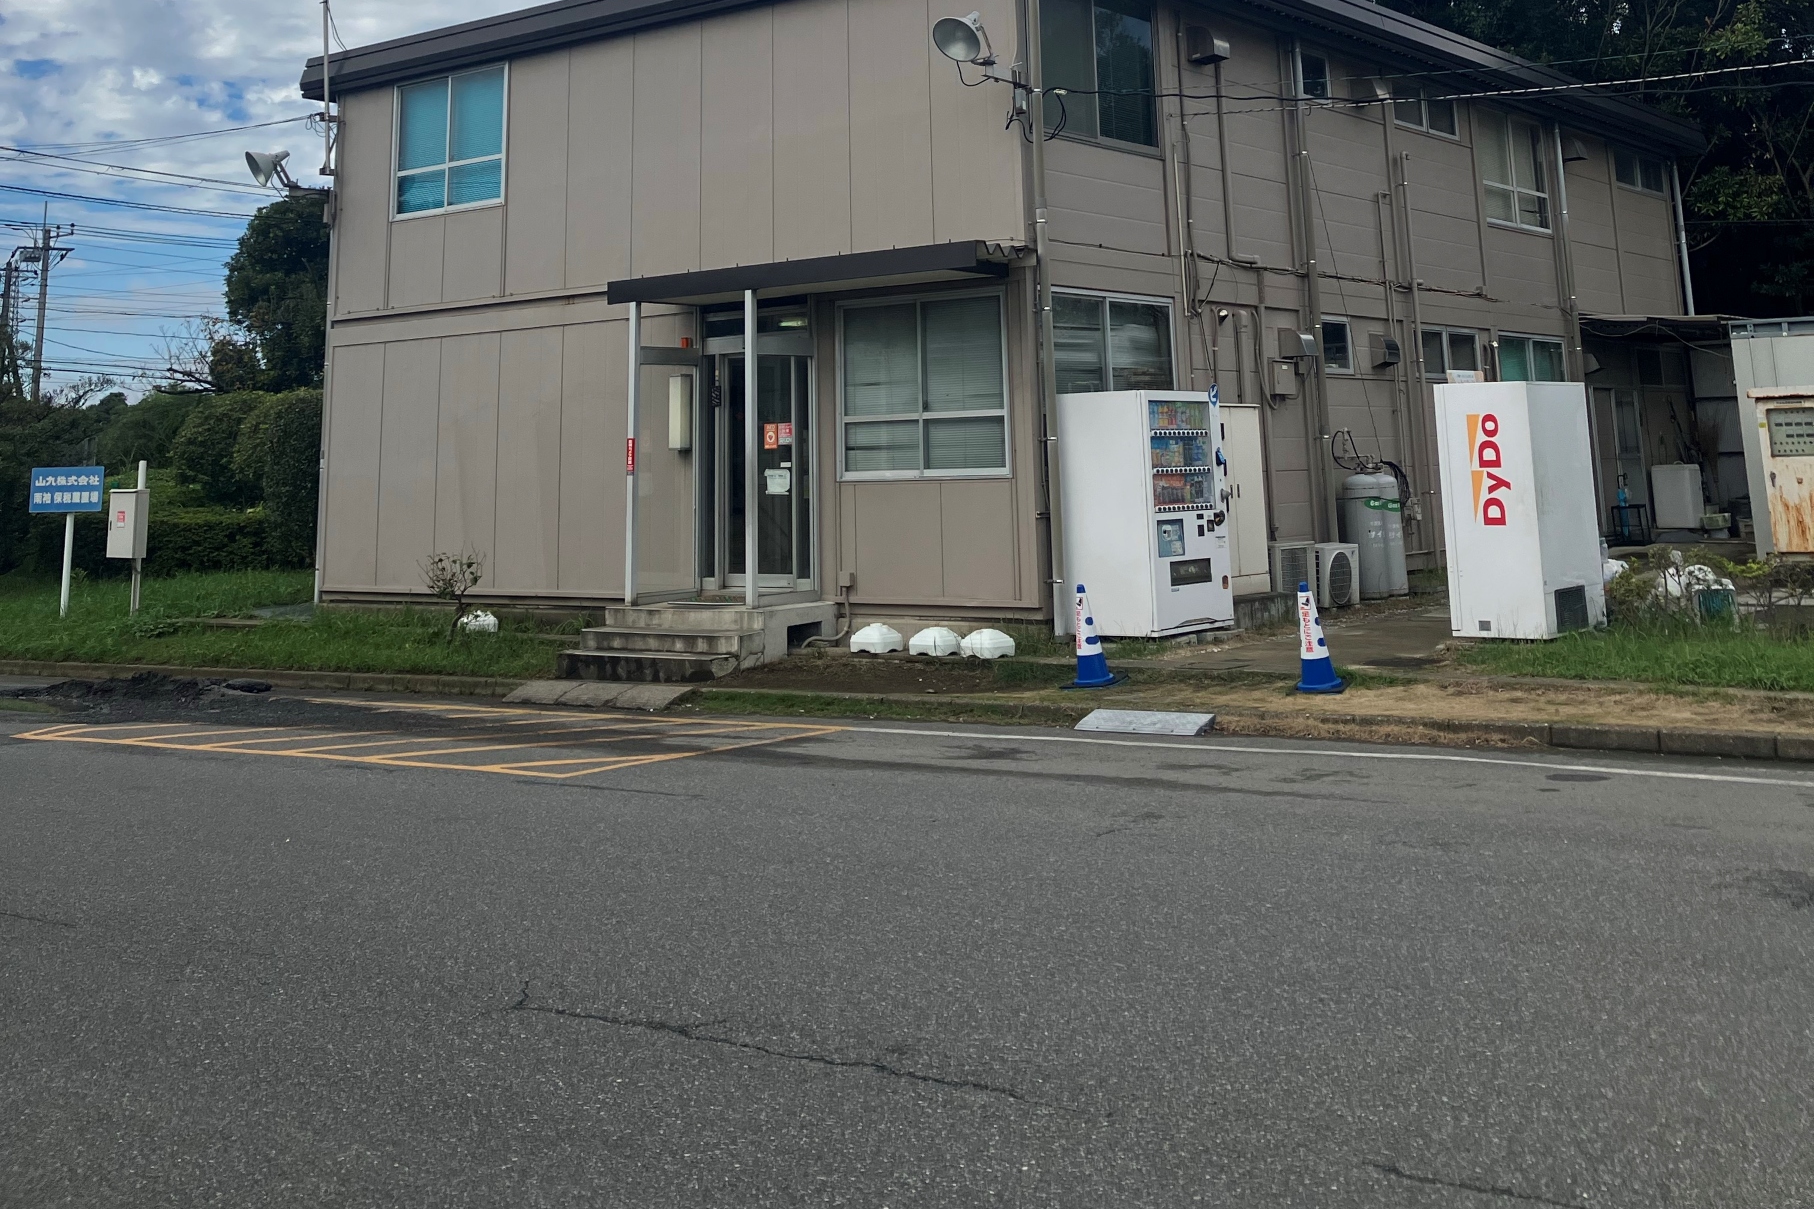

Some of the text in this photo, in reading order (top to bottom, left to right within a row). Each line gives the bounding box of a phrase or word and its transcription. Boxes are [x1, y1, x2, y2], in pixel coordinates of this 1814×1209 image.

[35, 475, 100, 486] 山九株式会社
[1477, 413, 1512, 526] DyDo
